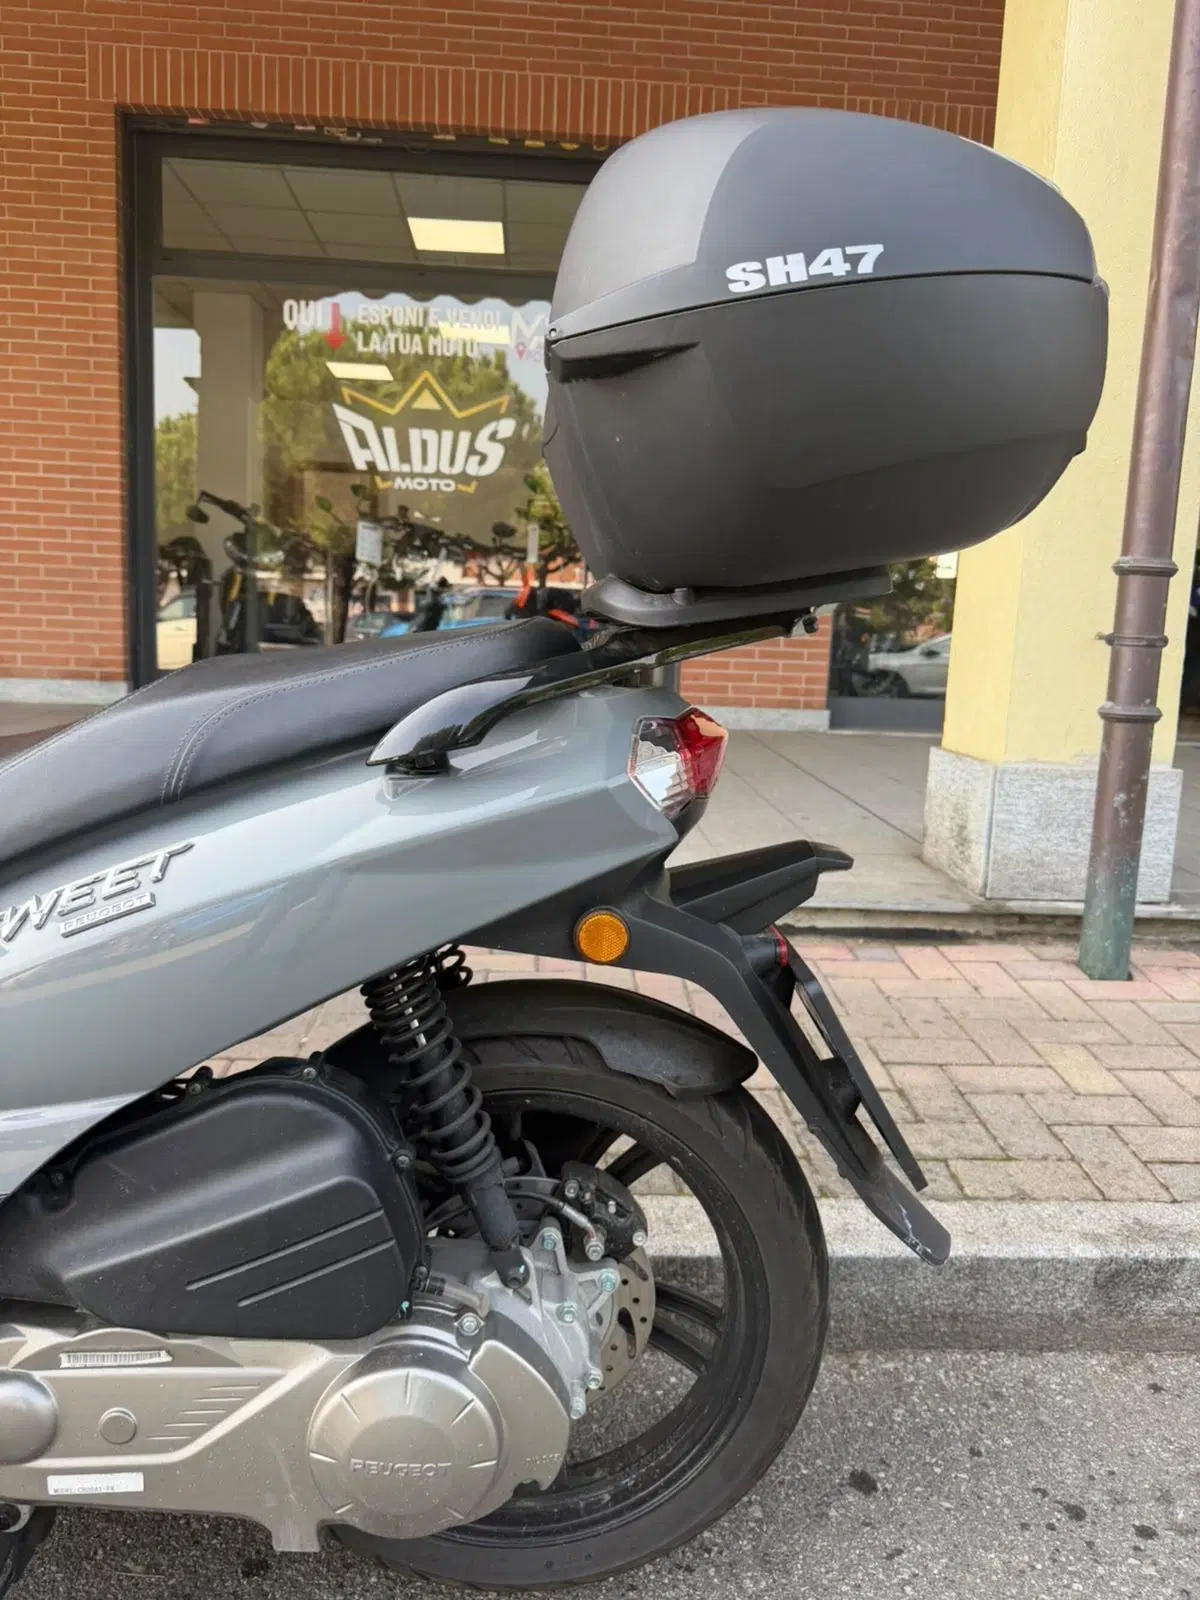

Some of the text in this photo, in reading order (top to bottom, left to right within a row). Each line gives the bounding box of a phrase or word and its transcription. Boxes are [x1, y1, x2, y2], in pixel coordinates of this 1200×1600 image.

[725, 244, 884, 293] SH47
[283, 299, 323, 331] QUI
[357, 304, 500, 332] ESPONI E VENDI
[357, 331, 478, 357] LA TUA MOTO
[332, 403, 516, 477] ALDUS
[393, 477, 456, 491] MOTO
[0, 842, 195, 943] WEET
[63, 894, 148, 931] PEUGEOT
[350, 1458, 452, 1477] PEUGEOT
